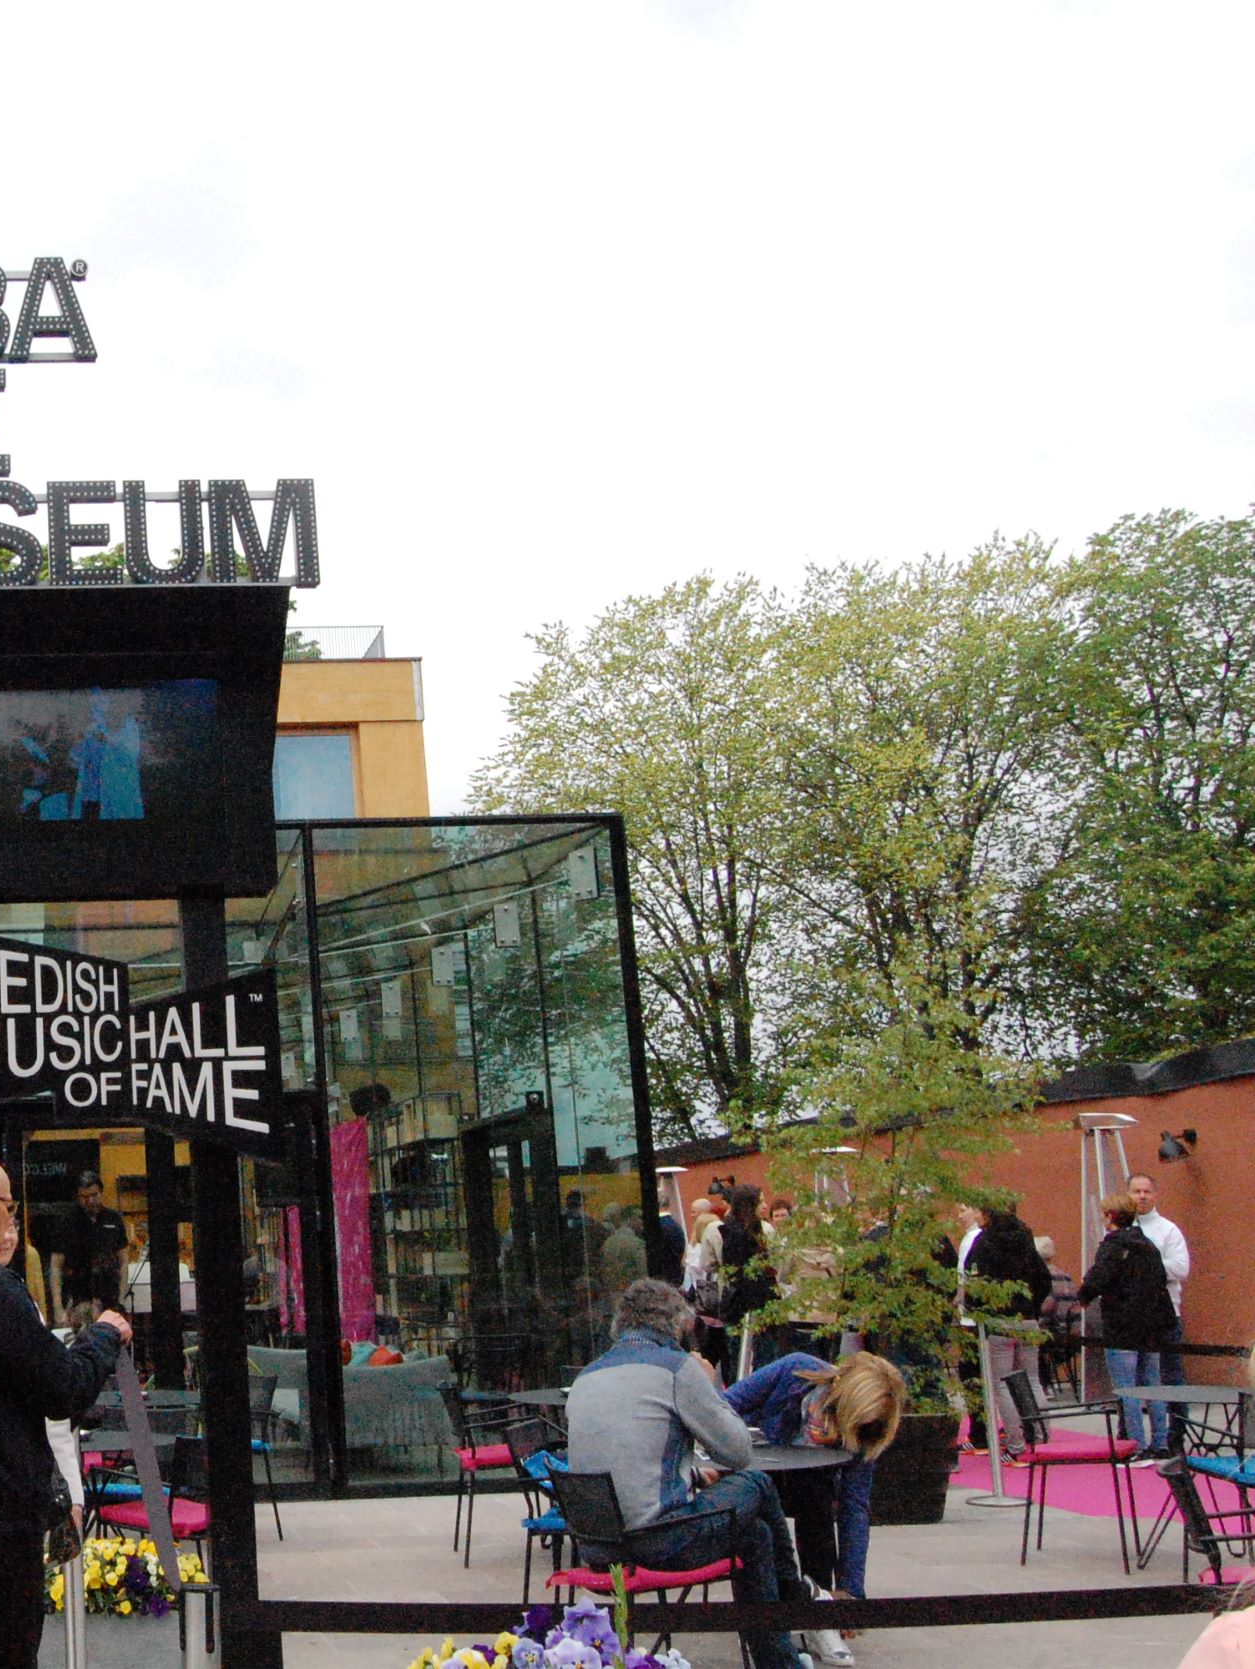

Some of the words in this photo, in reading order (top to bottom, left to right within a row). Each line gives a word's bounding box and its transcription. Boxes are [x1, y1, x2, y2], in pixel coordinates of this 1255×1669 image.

[129, 994, 266, 1059] HALL
[64, 1072, 122, 1107] OF
[131, 1060, 270, 1133] FAME
